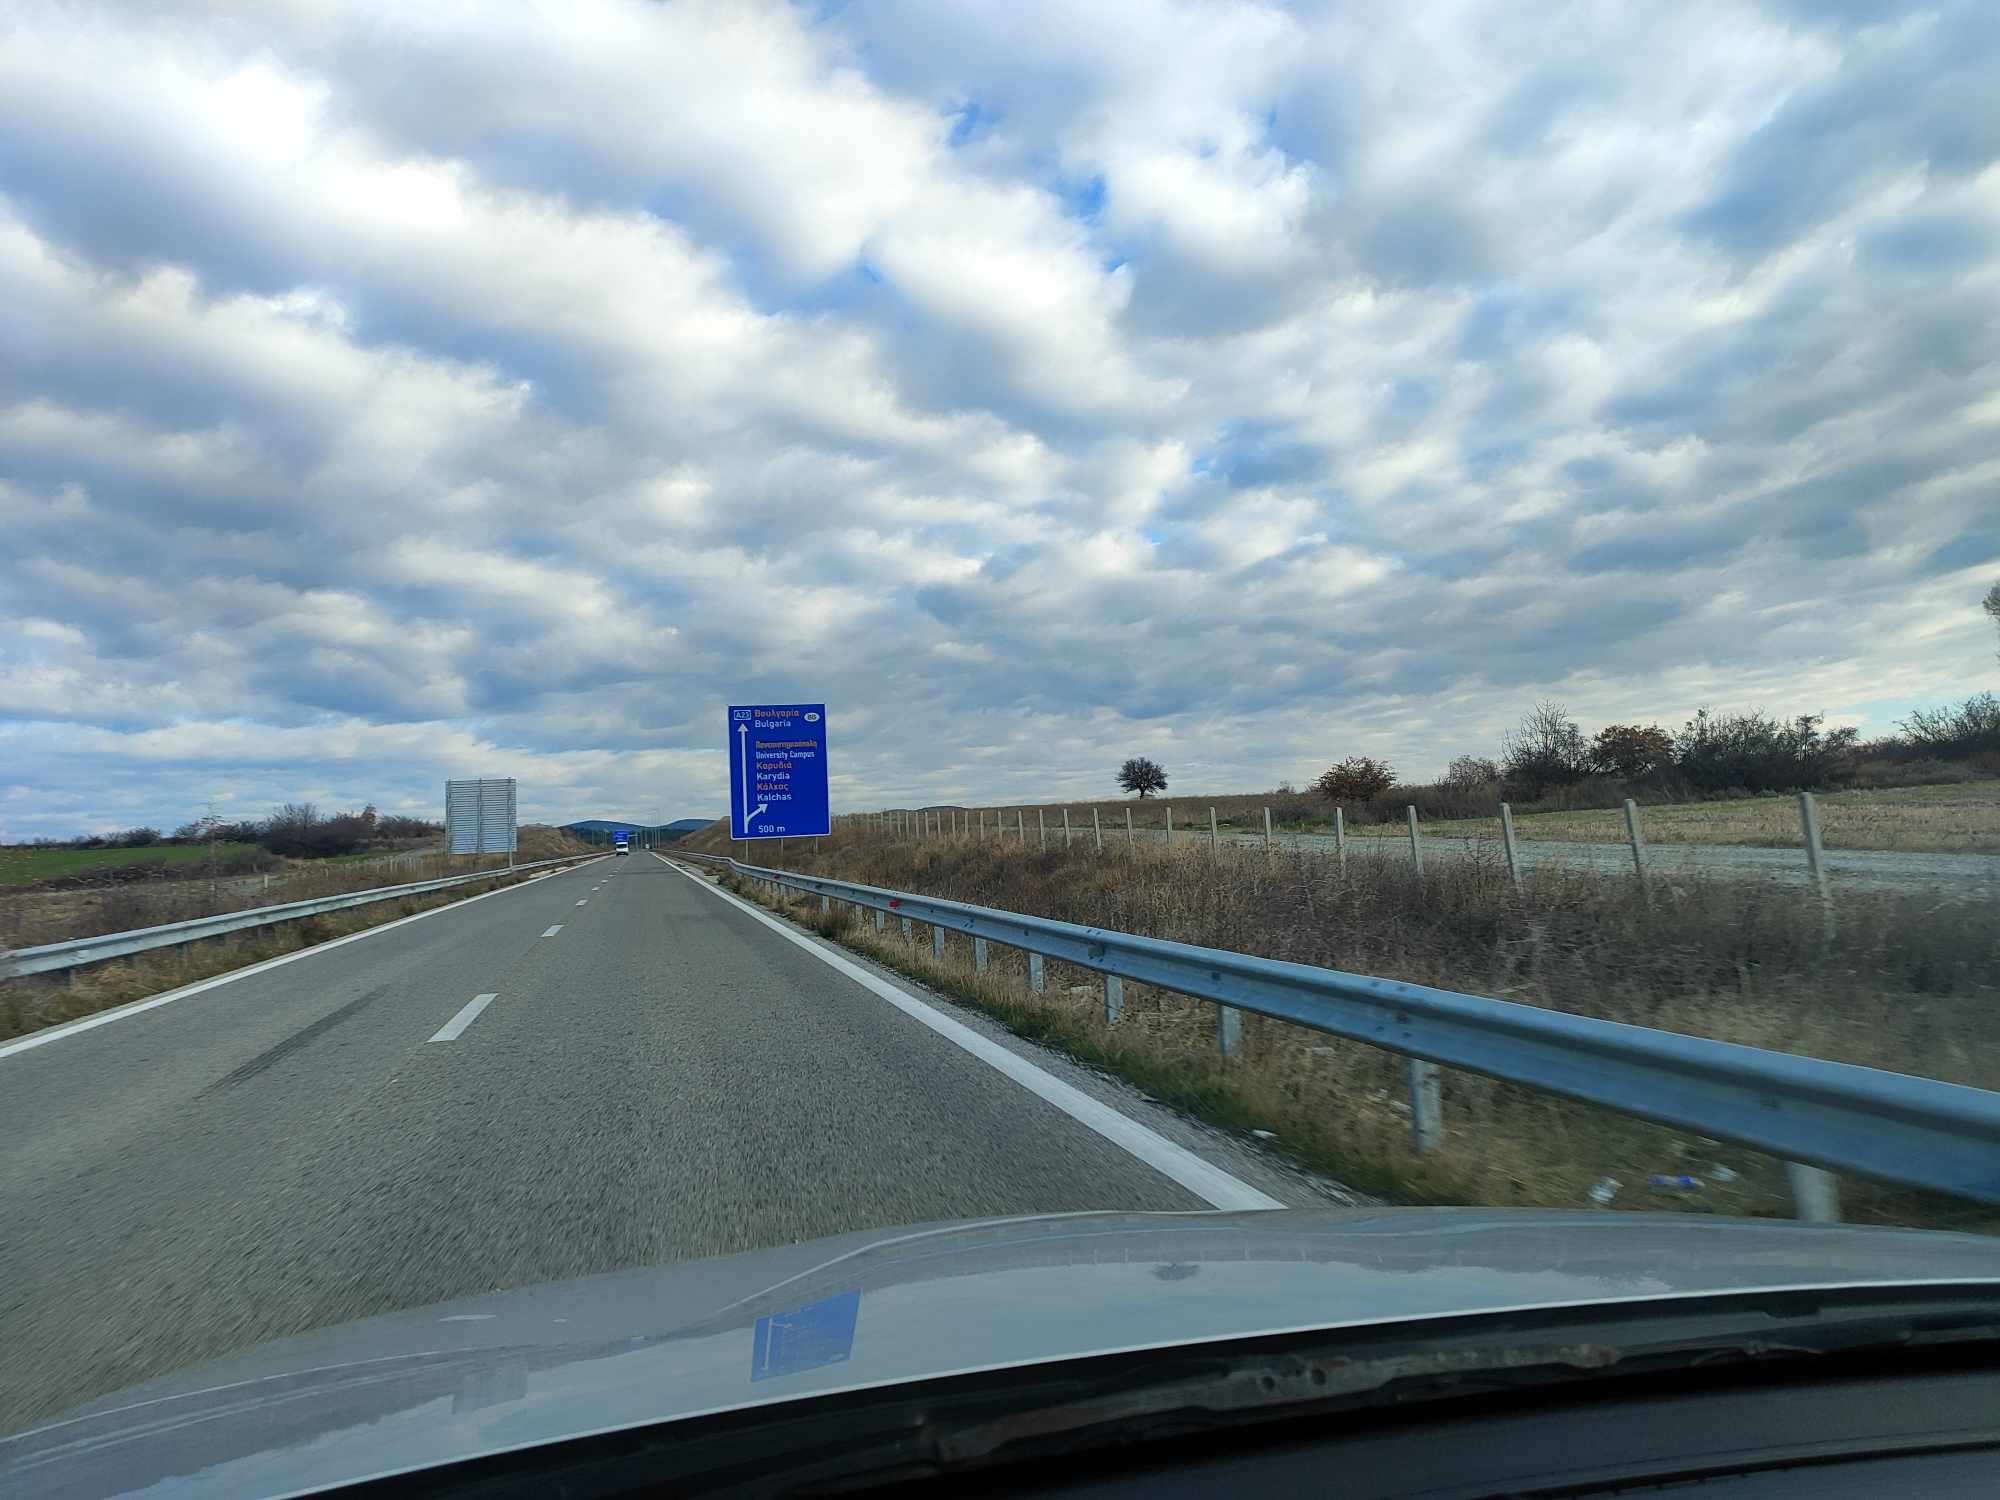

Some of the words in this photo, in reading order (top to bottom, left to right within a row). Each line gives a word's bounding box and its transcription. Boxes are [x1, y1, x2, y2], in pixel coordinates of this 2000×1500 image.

[754, 720, 791, 729] Bulgaria
[756, 751, 788, 760] University
[789, 750, 815, 760] Campus
[756, 771, 790, 781] Karydia
[757, 792, 792, 801] Kalchas
[758, 825, 774, 833] 500
[776, 825, 785, 833] m
